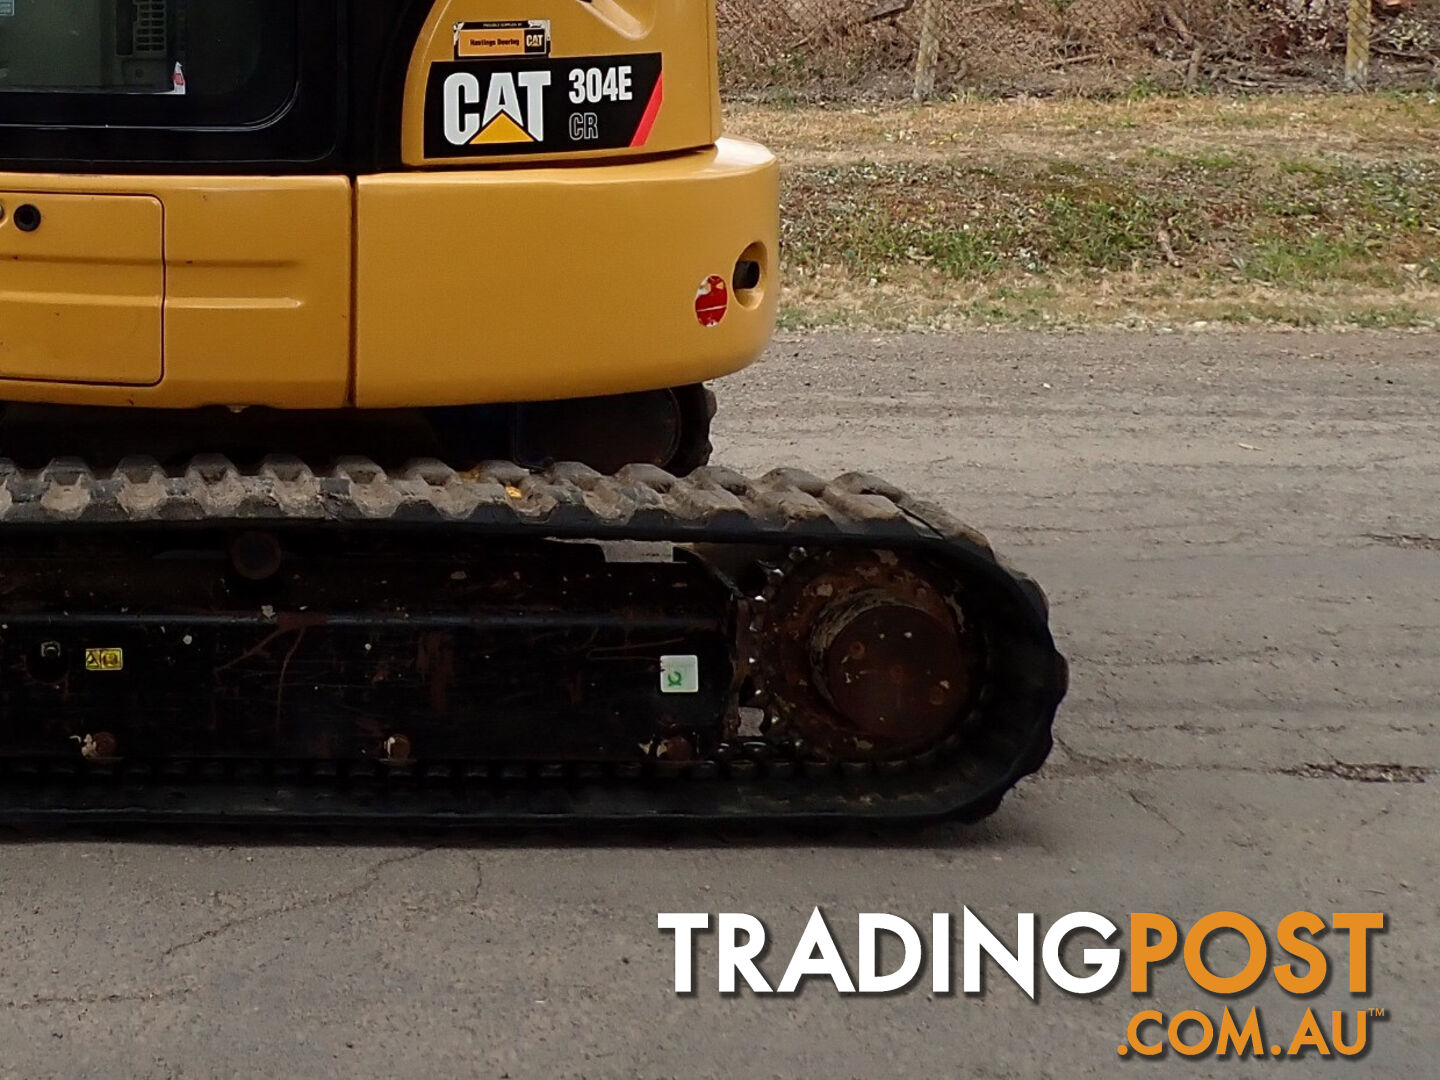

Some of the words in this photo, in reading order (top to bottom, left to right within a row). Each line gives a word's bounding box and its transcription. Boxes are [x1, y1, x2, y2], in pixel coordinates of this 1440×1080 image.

[526, 34, 543, 47] CAT
[568, 65, 633, 104] 304E
[443, 70, 551, 145] CAT
[569, 112, 599, 141] CR
